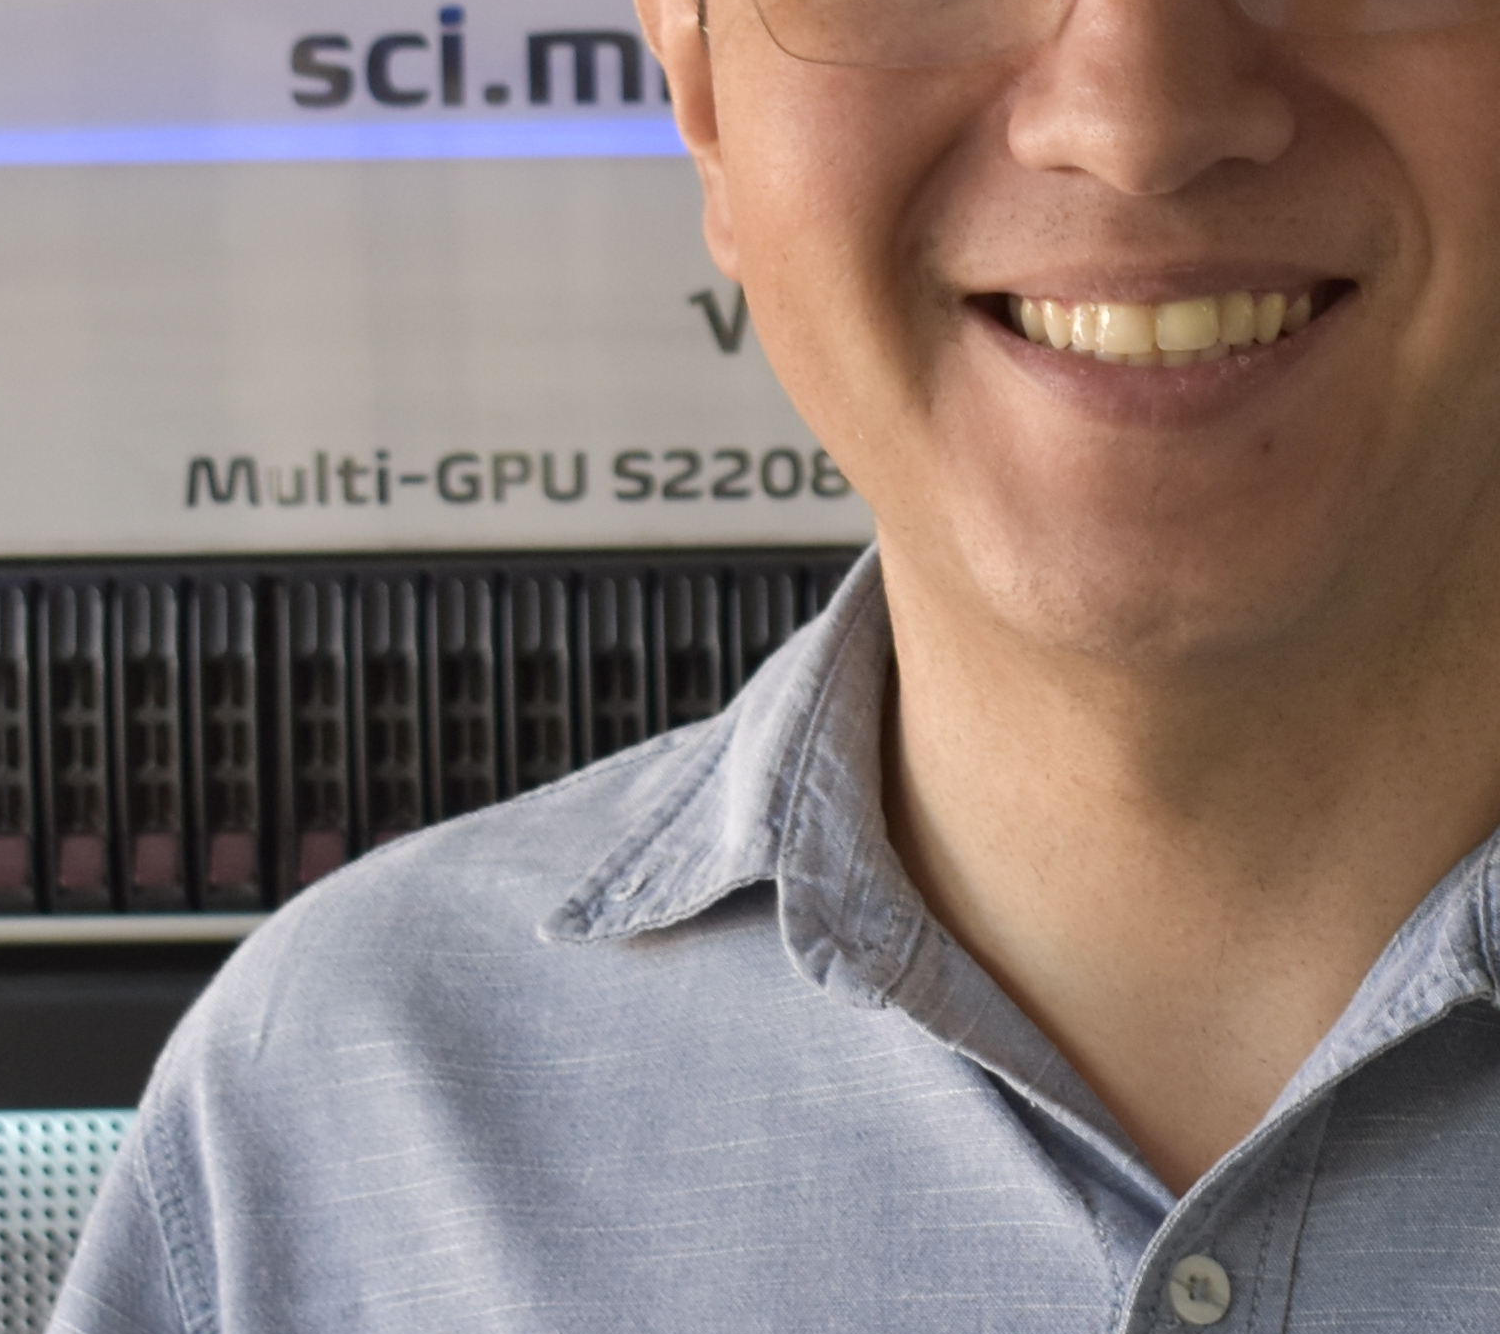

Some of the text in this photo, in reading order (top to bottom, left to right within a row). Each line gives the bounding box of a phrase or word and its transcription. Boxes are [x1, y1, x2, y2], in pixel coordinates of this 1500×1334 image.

[290, 6, 672, 108] sci.m
[184, 446, 852, 509] Multi-GPU S2208
